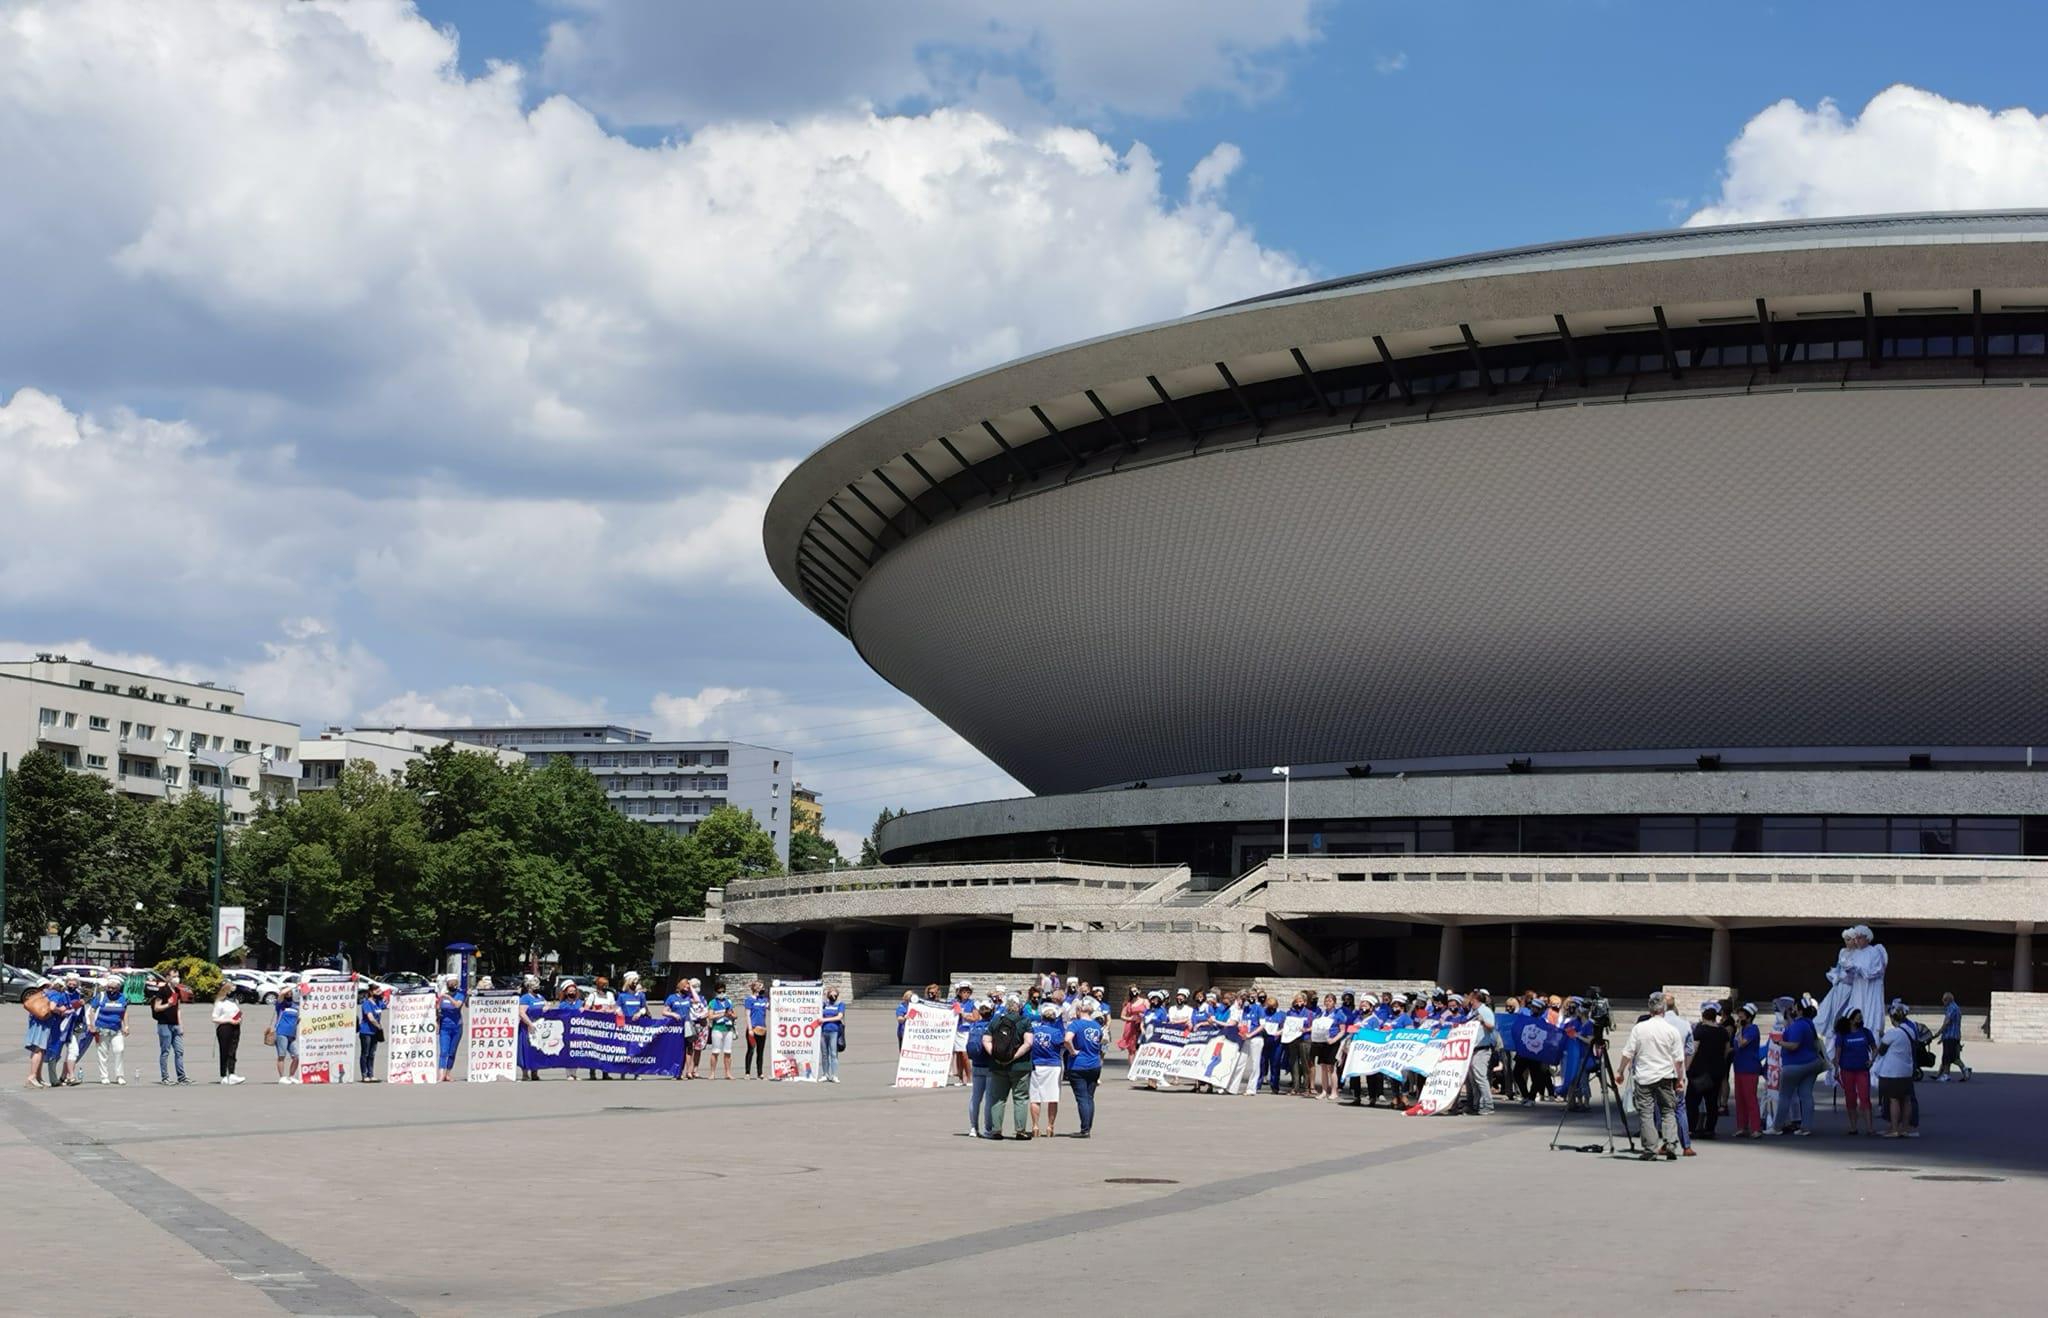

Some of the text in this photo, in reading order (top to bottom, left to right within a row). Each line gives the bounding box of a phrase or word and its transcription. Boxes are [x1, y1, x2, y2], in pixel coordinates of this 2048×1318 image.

[309, 985, 355, 993] ANDEMIA
[302, 1002, 355, 1010] CHAOSU
[311, 1013, 344, 1023] DODATKI
[391, 1022, 435, 1035] CIĘŻKO
[474, 1027, 509, 1037] DOŚĆ
[777, 1024, 815, 1038] 300
[471, 1040, 514, 1048] PRACY
[391, 1049, 434, 1060] SZYBKO
[1442, 1041, 1468, 1058] AK!
[471, 1051, 513, 1059] PONAD
[471, 1062, 513, 1070] LUDZKIE
